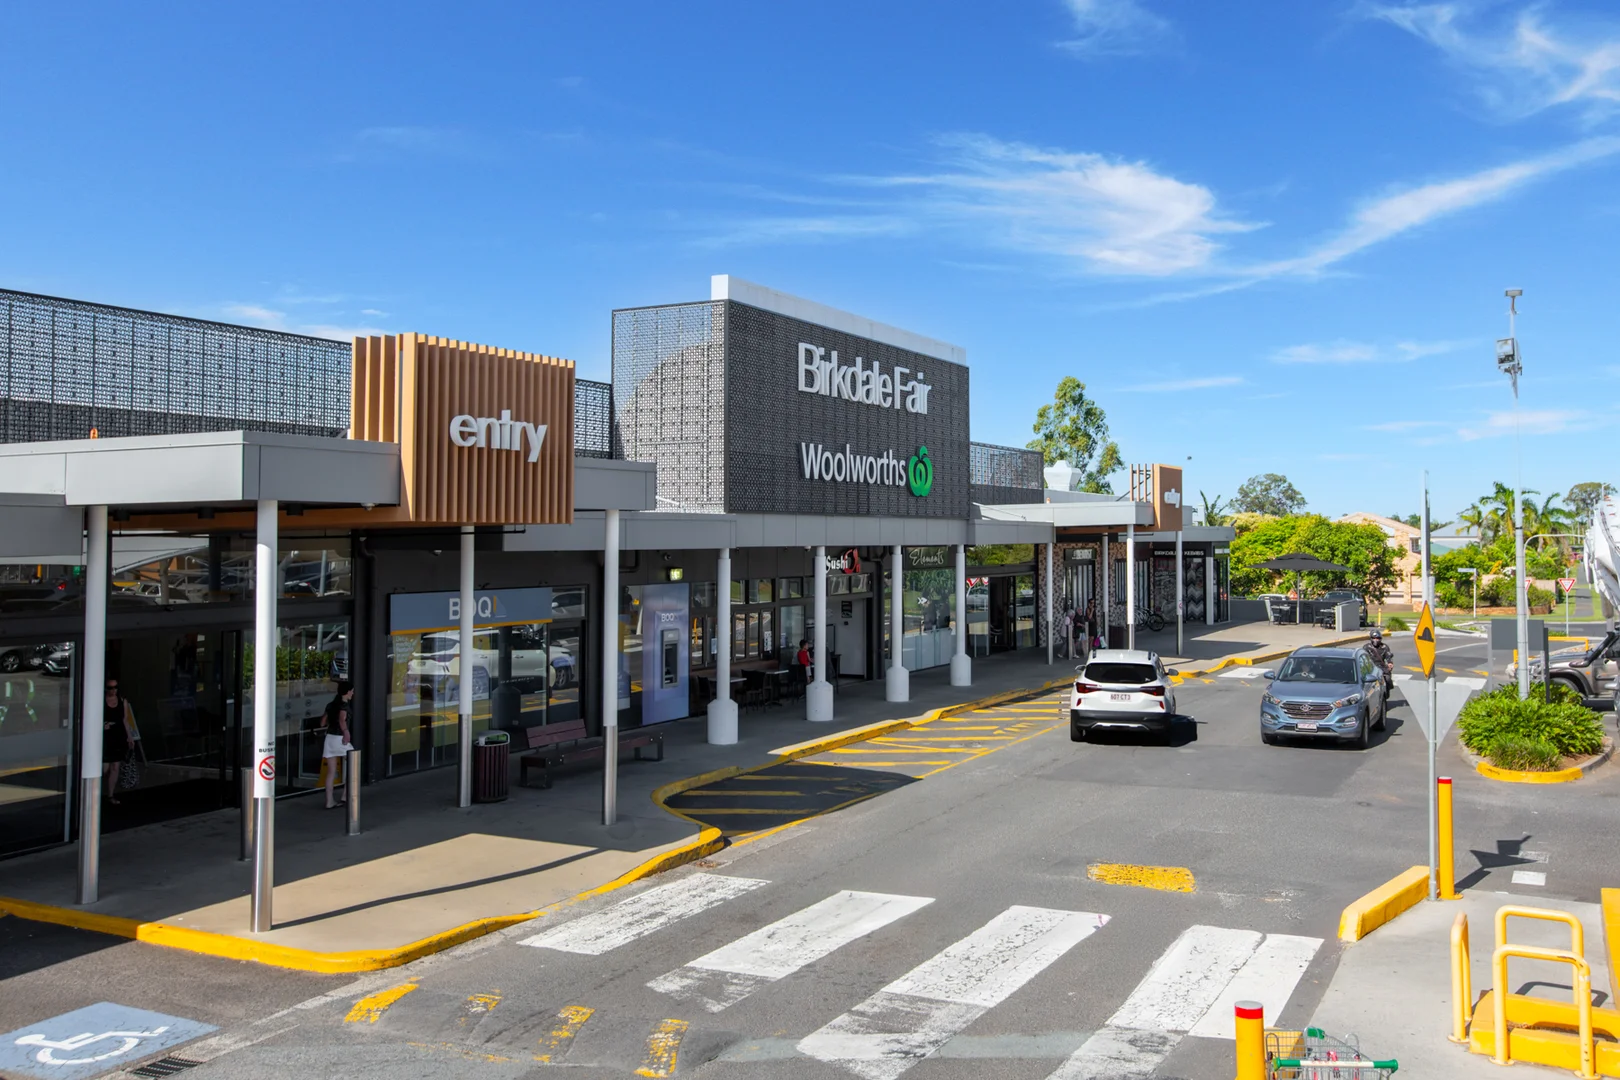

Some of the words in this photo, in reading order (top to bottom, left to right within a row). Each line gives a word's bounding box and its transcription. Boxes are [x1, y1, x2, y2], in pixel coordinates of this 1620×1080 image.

[798, 342, 893, 408] Birkdale
[894, 366, 932, 414] Fair
[449, 409, 548, 463] entry
[801, 442, 906, 486] Woolworths
[825, 555, 848, 574] Sushi
[909, 548, 944, 566] Elements
